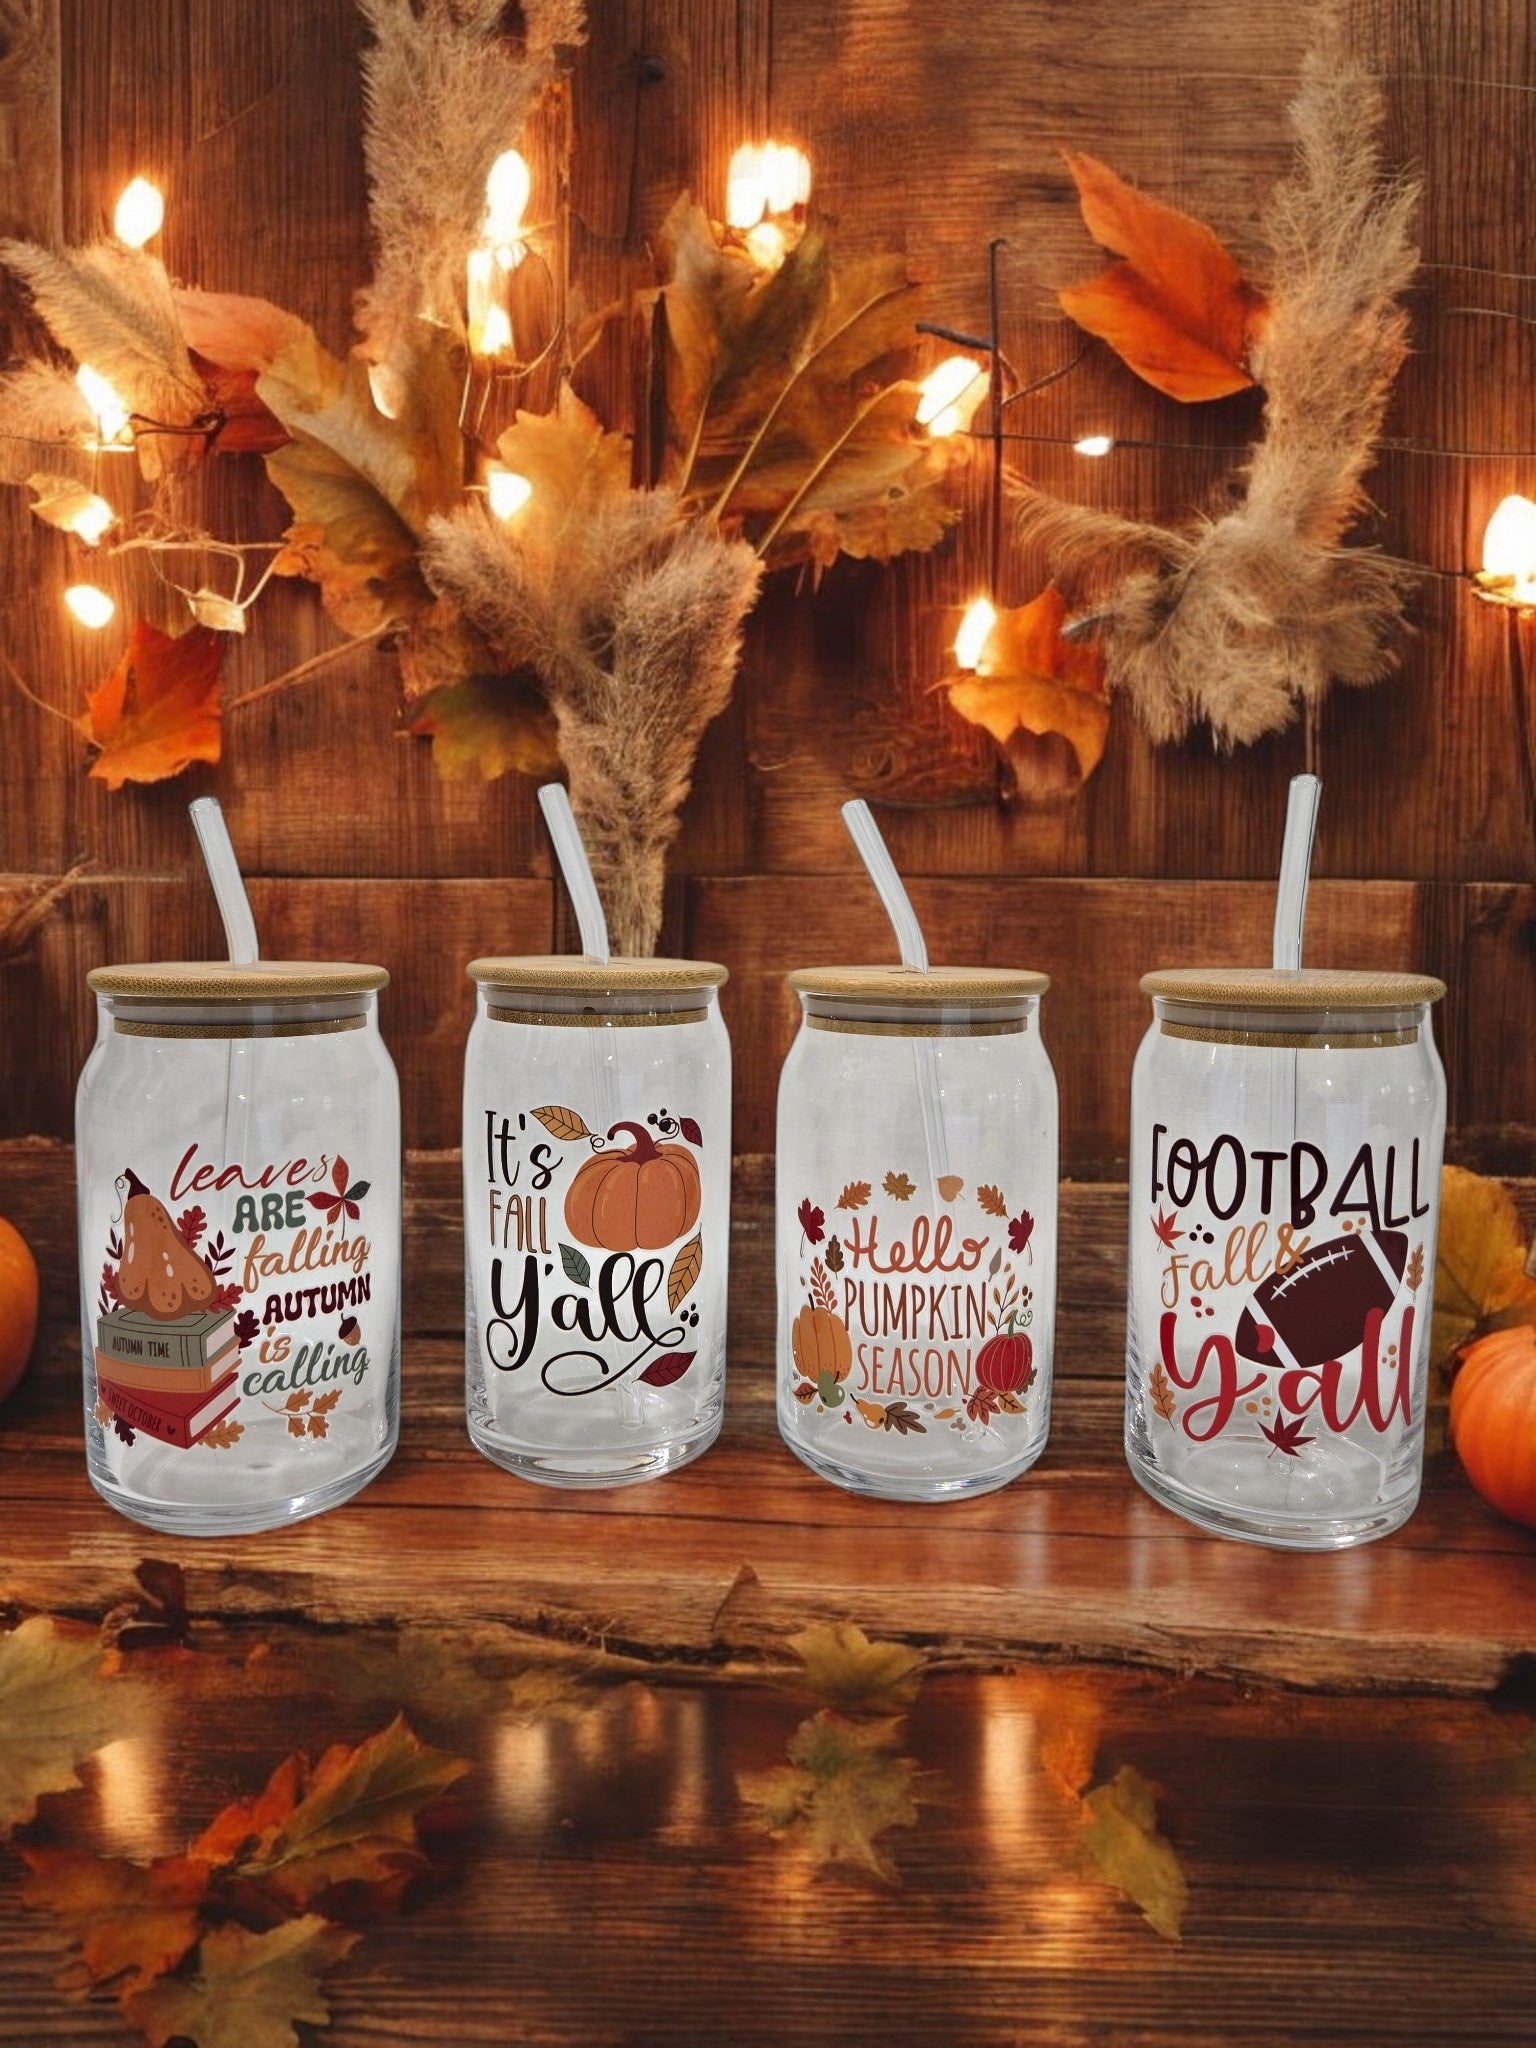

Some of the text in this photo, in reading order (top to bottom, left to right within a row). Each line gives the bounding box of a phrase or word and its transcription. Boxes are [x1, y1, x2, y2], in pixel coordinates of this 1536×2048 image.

[169, 1143, 332, 1201] leaves
[485, 1110, 564, 1190] It's
[1152, 1123, 1430, 1231] FOOTBALL
[232, 1190, 307, 1234] ARE
[490, 1189, 552, 1255] FALL
[243, 1226, 371, 1294] falling
[843, 1214, 990, 1274] Hello
[262, 1273, 372, 1326] AUTUMN
[843, 1277, 987, 1342] PUMPKIN
[112, 1335, 171, 1358] AUTUMN TIME
[242, 1341, 372, 1397] calling
[259, 1326, 291, 1364] is
[857, 1343, 972, 1398] SEASON
